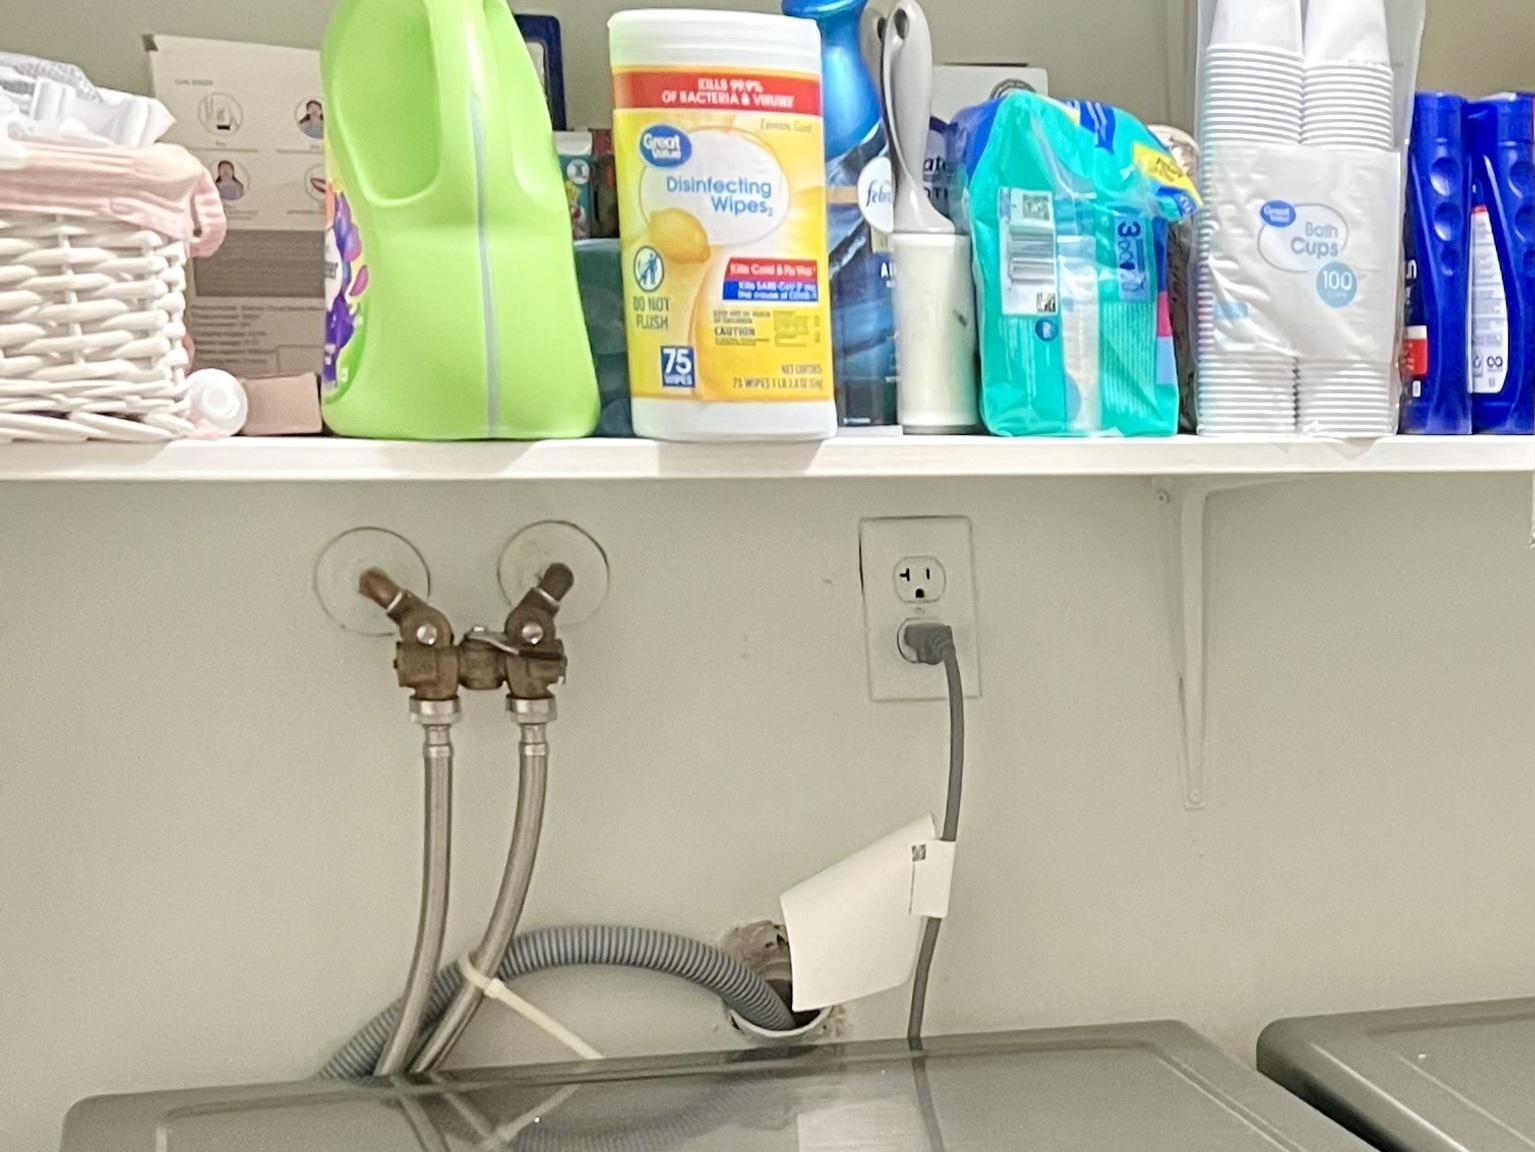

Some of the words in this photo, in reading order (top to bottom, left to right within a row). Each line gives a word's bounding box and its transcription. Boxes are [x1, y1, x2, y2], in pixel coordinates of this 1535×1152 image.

[698, 78, 728, 91] KILLS
[661, 90, 677, 103] OF
[679, 90, 739, 105] BACTERIA
[741, 94, 750, 106] &
[760, 119, 791, 132] Lemon
[643, 133, 680, 151] Great
[651, 149, 681, 160] Value
[666, 176, 772, 199] Disinfecting
[1263, 204, 1290, 215] Great
[1305, 221, 1338, 239] Bath
[1290, 236, 1339, 260] Cups
[1322, 270, 1352, 290] 100
[633, 296, 646, 312] DO
[647, 296, 670, 312] NOT
[636, 313, 669, 330] FLUSH
[663, 348, 692, 375] 75
[664, 374, 693, 386] WIPES
